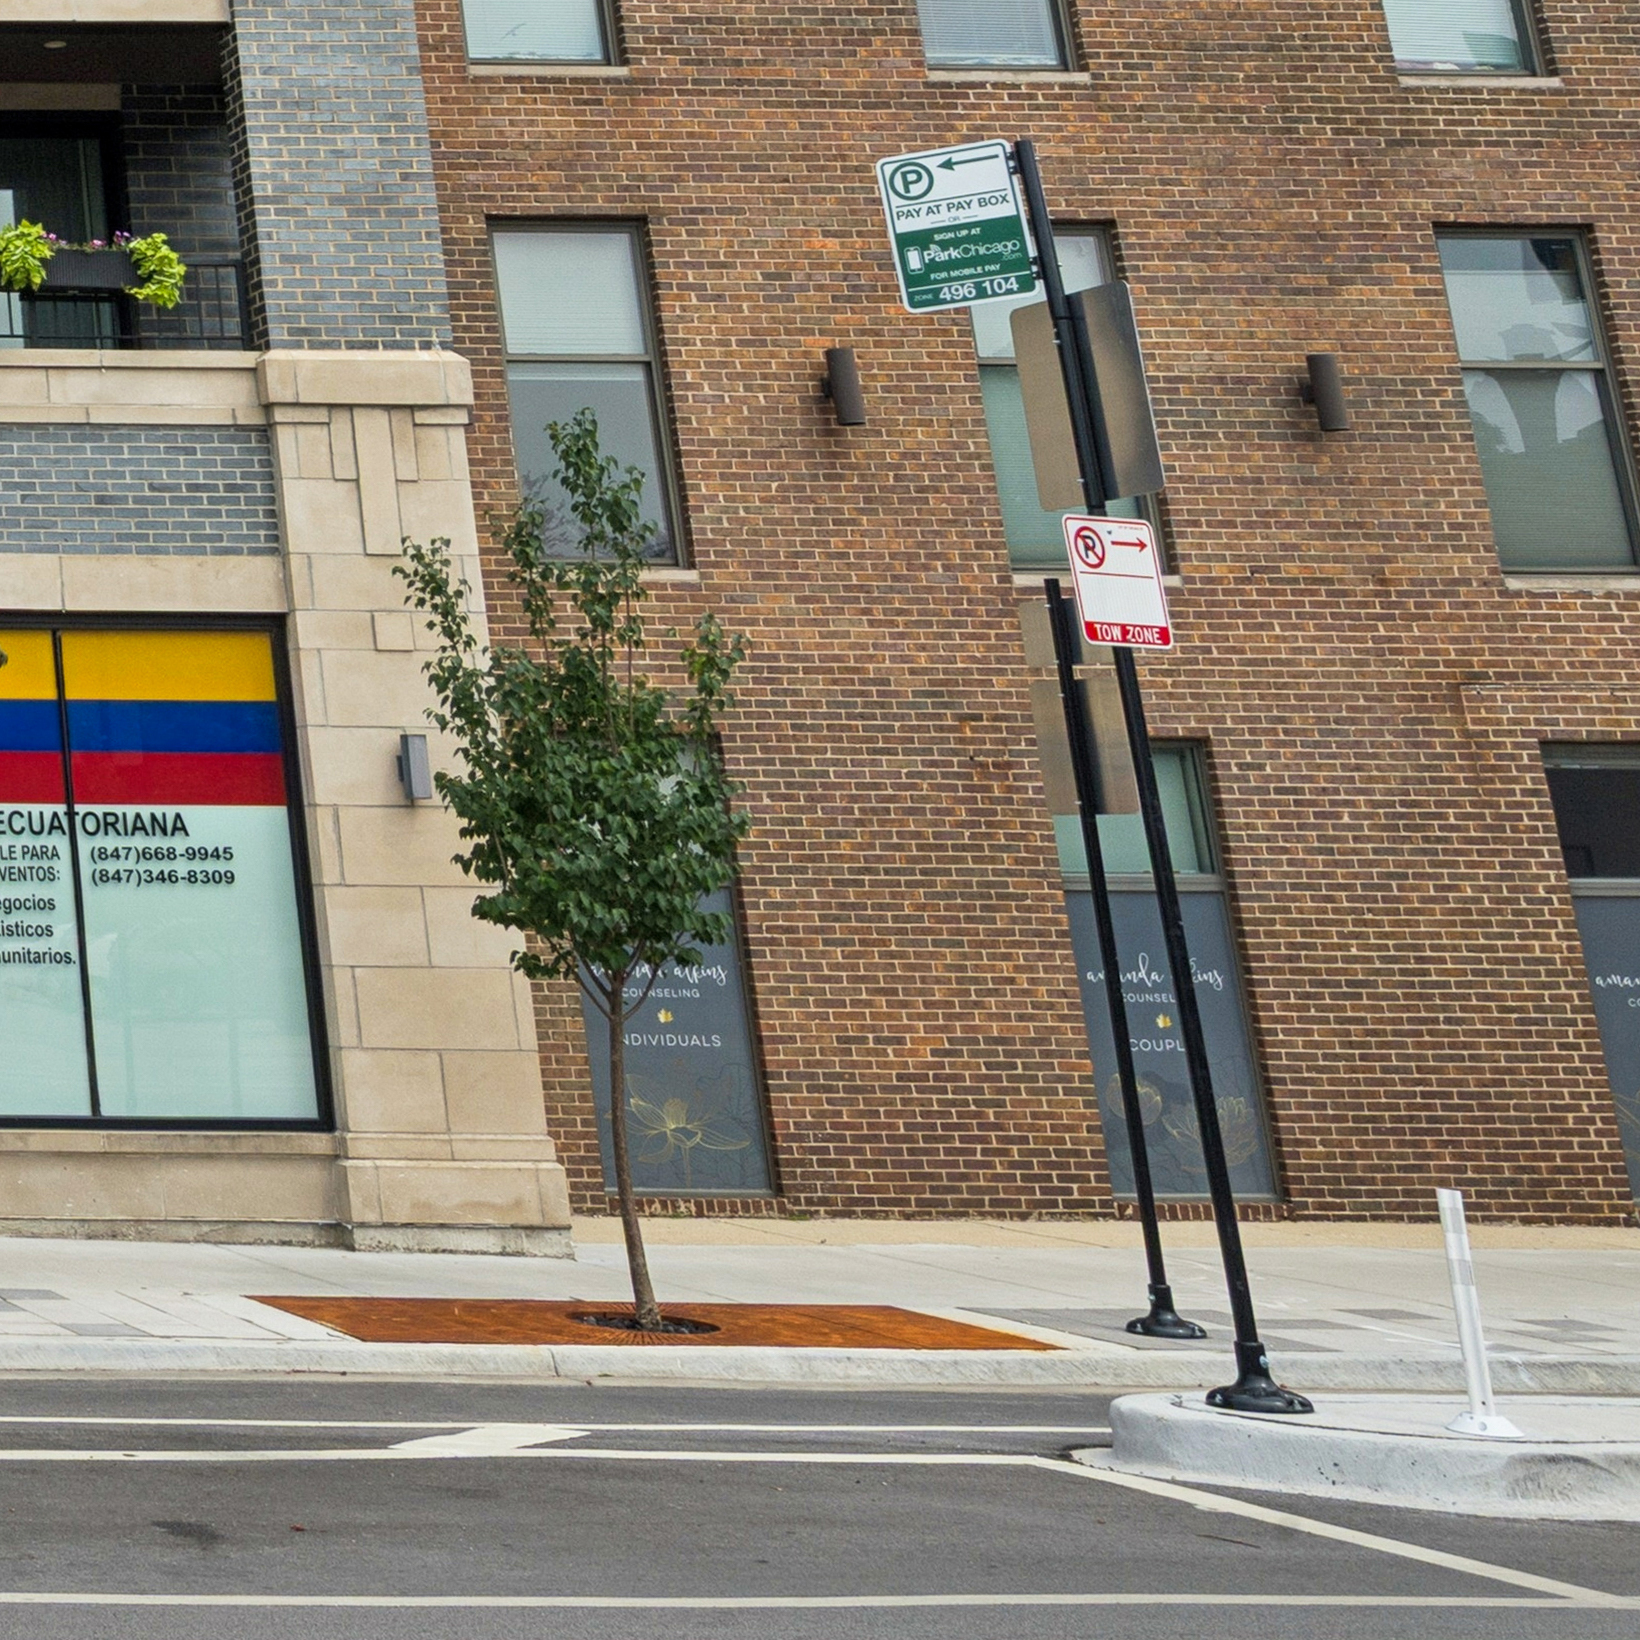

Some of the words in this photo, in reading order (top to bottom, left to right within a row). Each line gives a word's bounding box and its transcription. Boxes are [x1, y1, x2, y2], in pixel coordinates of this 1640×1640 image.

[896, 208, 922, 221] PAY
[926, 204, 942, 217] AT
[947, 200, 973, 213] PAY
[978, 193, 1010, 208] BOX
[933, 232, 955, 241] SIGN
[956, 230, 969, 238] UP
[970, 227, 982, 236] AT
[923, 239, 1021, 264] ParkChicago
[930, 272, 948, 280] FOR
[950, 267, 983, 277] MOBILE
[984, 263, 1001, 272] PAY
[939, 283, 977, 301] 496
[982, 276, 1019, 295] 104
[1094, 624, 1122, 641] TOW
[1125, 626, 1163, 643] ZONE
[21, 846, 60, 861] PARA
[90, 846, 234, 865] (847)668-9945
[91, 869, 236, 887] (847)346-8309
[621, 987, 701, 998] COUNSELING
[623, 1033, 722, 1048] NDIVIDUALS
